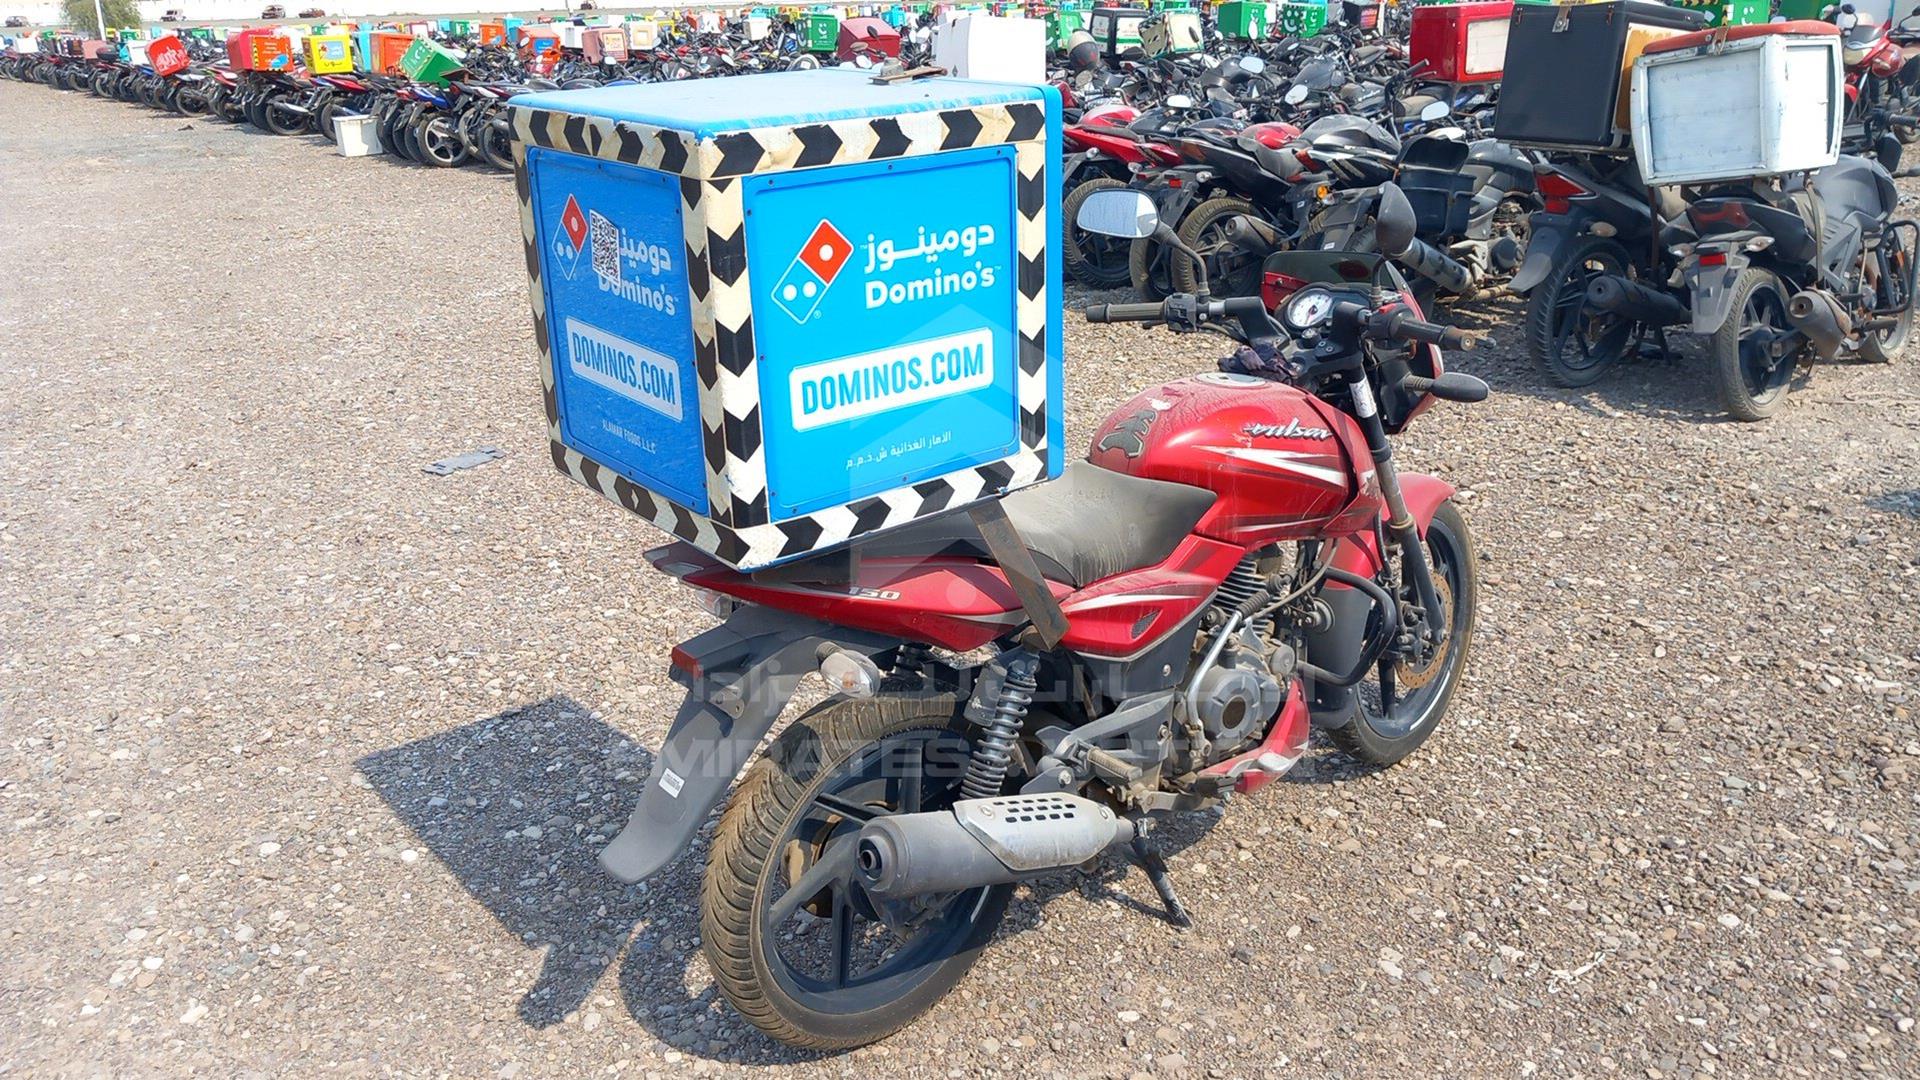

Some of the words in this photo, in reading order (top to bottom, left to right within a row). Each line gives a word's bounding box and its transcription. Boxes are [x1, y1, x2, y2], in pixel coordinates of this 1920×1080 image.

[620, 227, 671, 276] دومين
[864, 224, 995, 274] دومينوز
[864, 260, 995, 309] Domino's
[572, 331, 676, 405] DOMINOS.COM
[801, 343, 984, 415] DOMINOS.COM
[848, 586, 901, 600] 150
